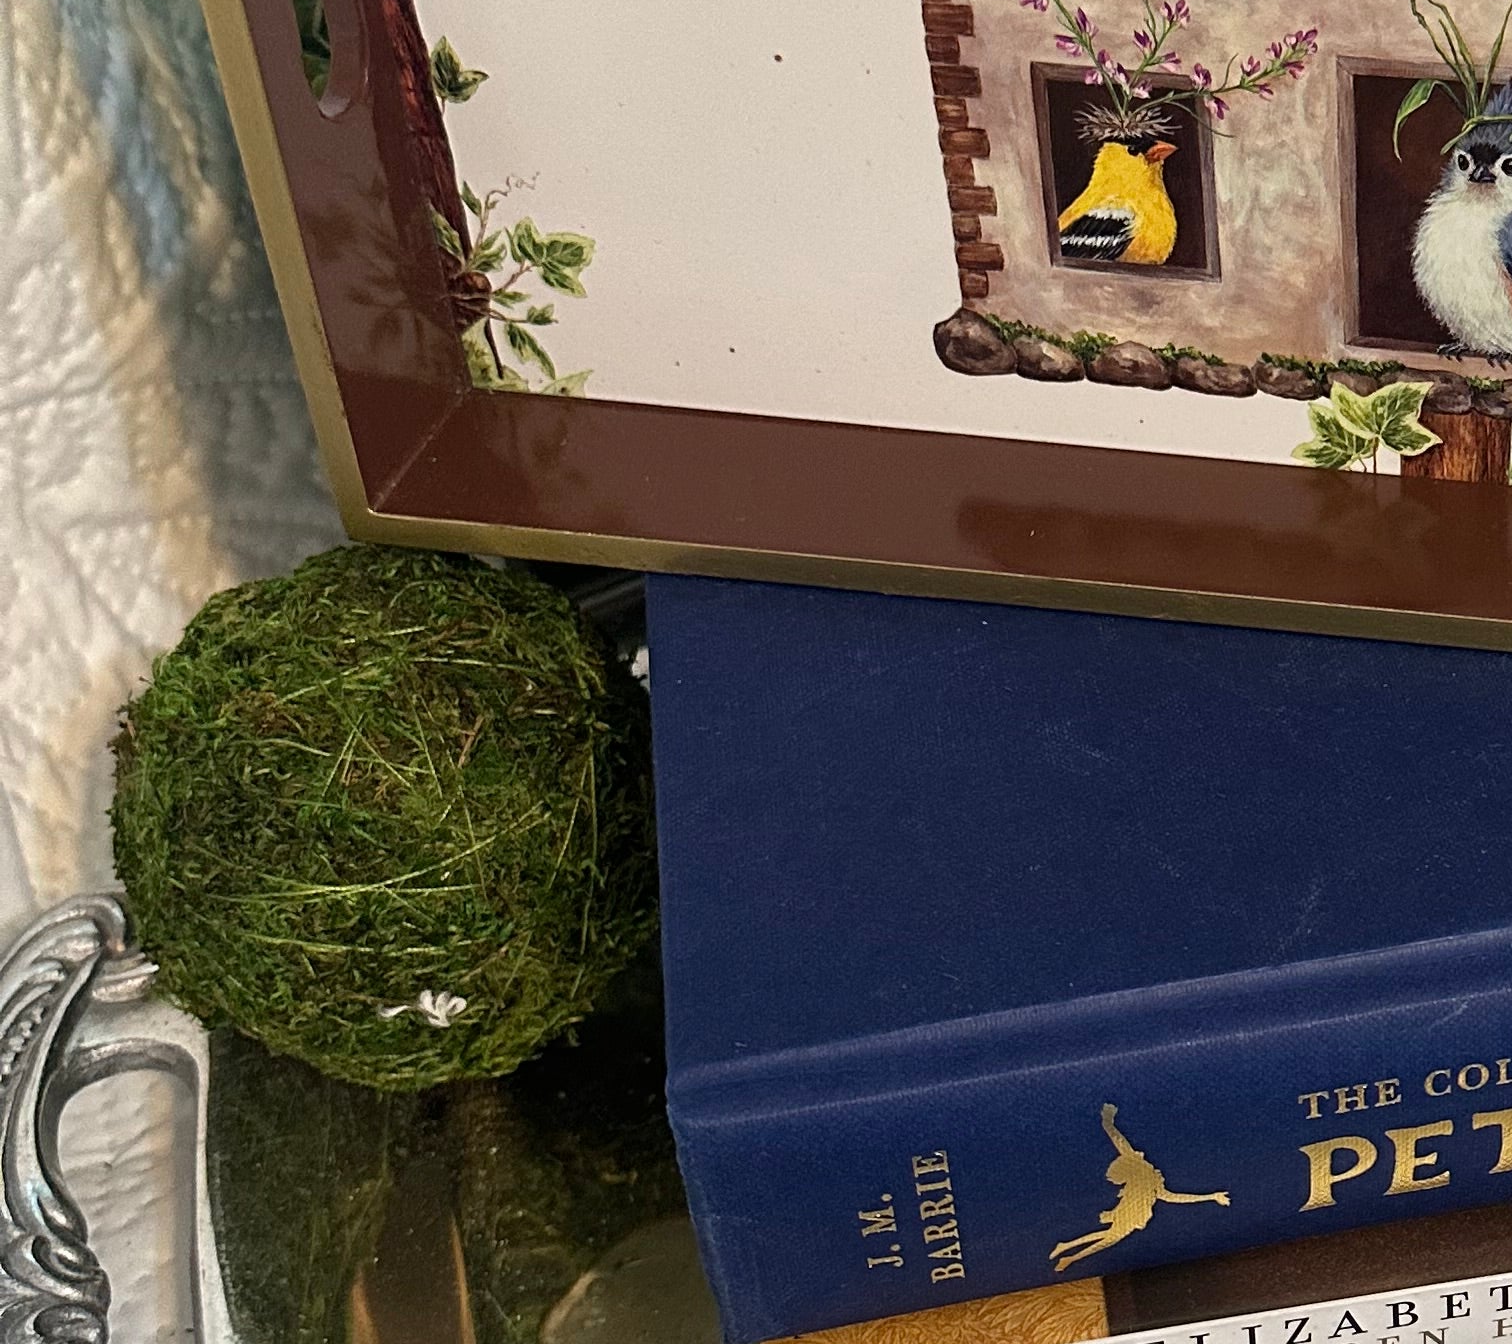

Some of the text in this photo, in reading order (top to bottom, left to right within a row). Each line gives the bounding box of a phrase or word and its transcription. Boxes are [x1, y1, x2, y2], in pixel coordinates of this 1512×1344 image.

[1298, 1077, 1402, 1120] THE
[857, 1192, 905, 1269] J. M.
[911, 1149, 966, 1285] BARRIE
